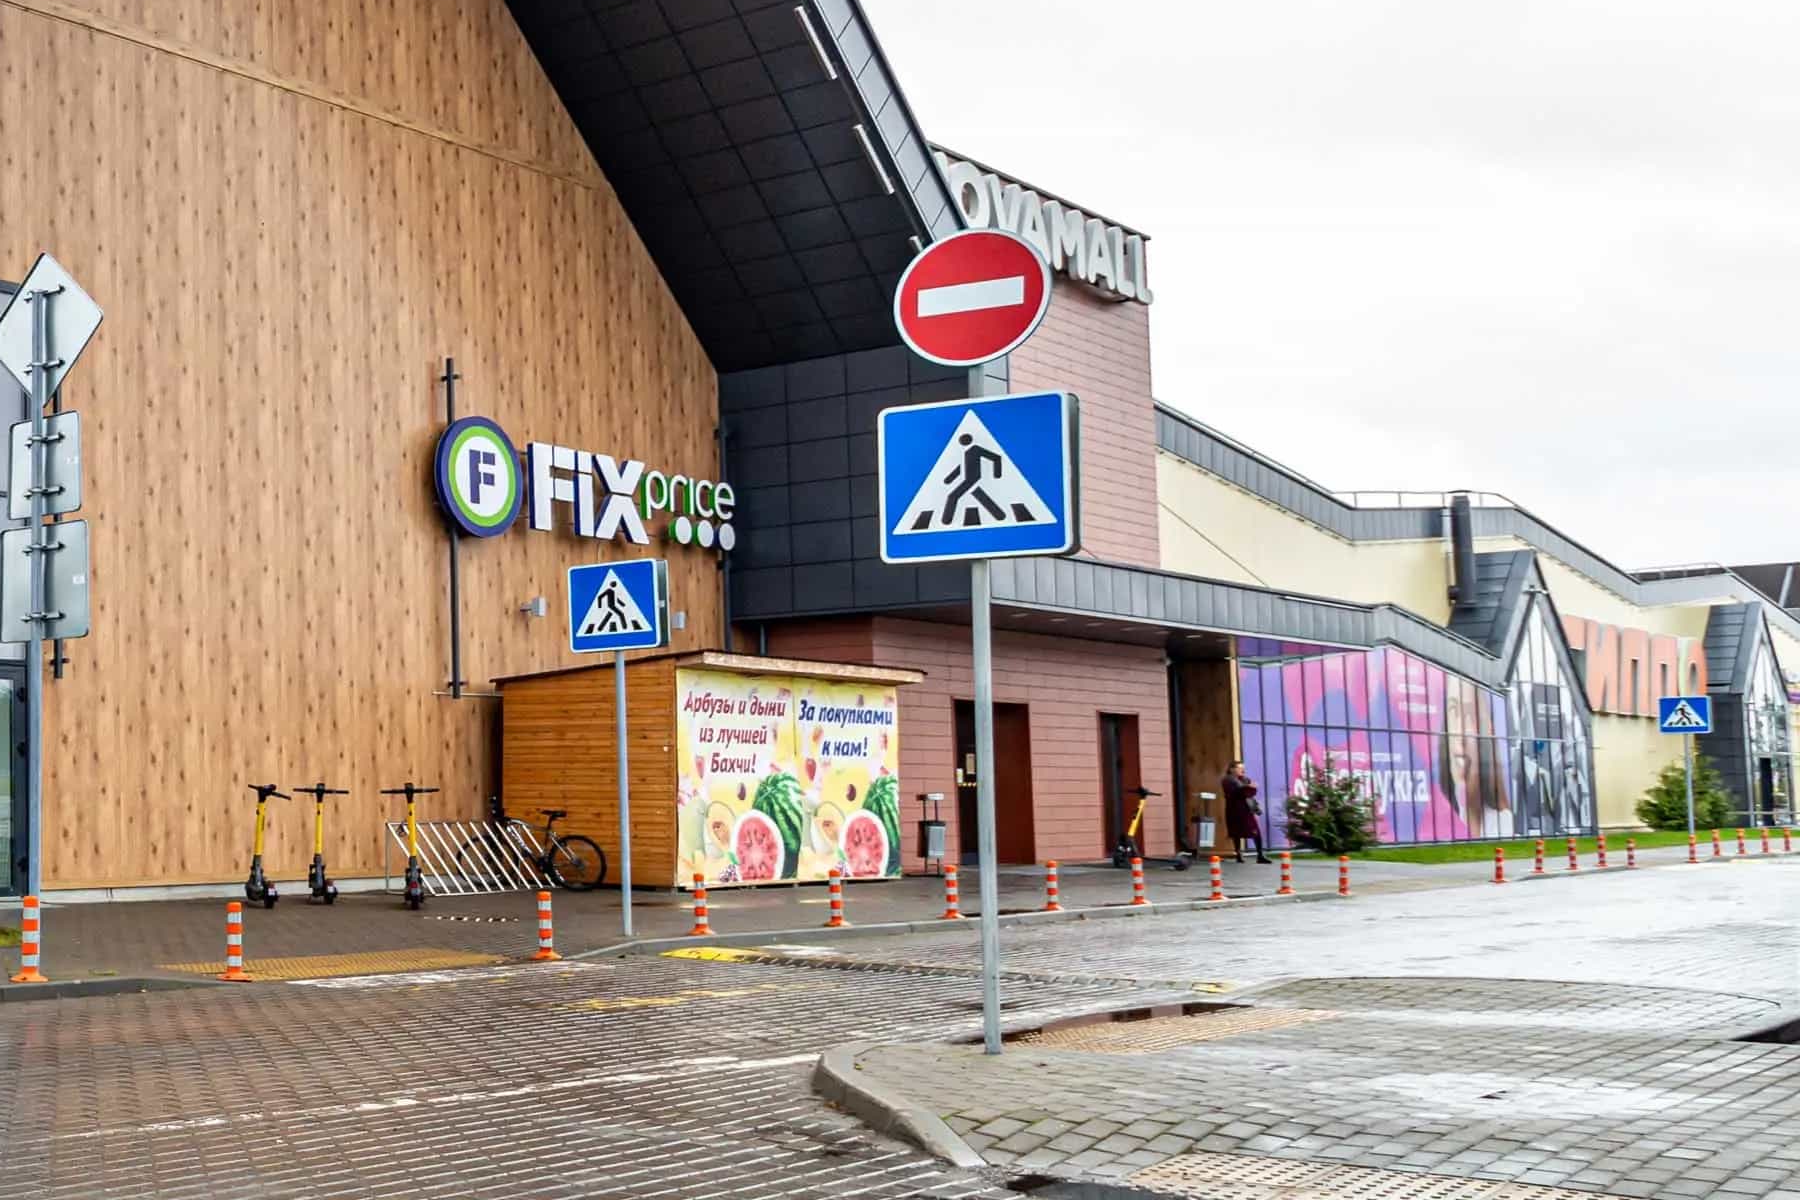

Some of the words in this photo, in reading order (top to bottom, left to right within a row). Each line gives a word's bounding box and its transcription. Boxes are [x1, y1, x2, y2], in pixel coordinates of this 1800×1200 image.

[935, 152, 1153, 304] OVAMALL
[641, 470, 735, 520] price
[1562, 614, 1708, 717] ИППО
[684, 692, 735, 718] Арбузы
[738, 700, 748, 714] и
[750, 695, 786, 717] дыни
[799, 699, 815, 721] За
[818, 706, 893, 728] покупками
[700, 727, 714, 743] из
[716, 725, 768, 748] лучшей
[821, 743, 831, 756] к
[833, 737, 868, 757] нам!
[710, 753, 757, 774] Бахчи!
